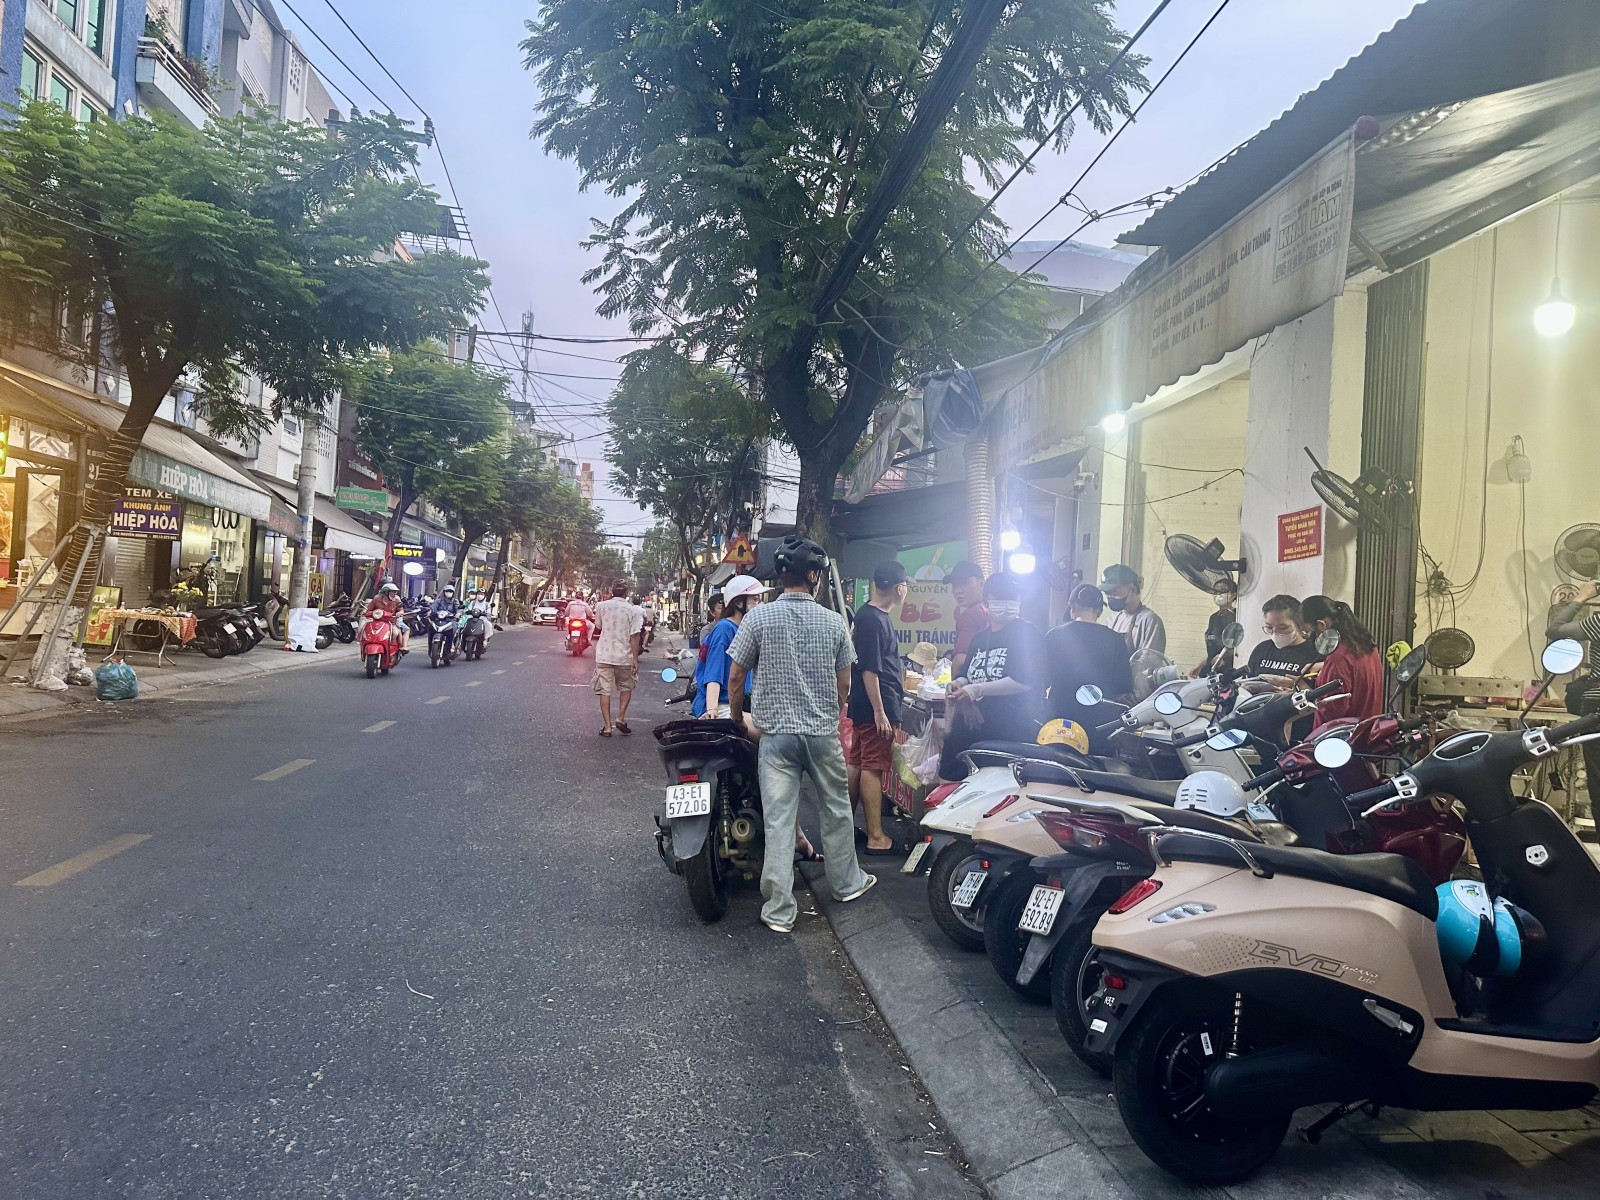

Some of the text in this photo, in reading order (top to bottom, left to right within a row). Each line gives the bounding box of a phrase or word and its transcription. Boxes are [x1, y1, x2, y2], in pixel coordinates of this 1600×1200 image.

[160, 464, 188, 495] HIỆP
[189, 473, 208, 499] HÒA
[125, 486, 173, 499] TEM XE
[123, 501, 172, 512] KHUNG ẢNH
[113, 510, 147, 530] HIỆP
[149, 512, 178, 531] HÒA
[900, 597, 942, 623] BÉ
[916, 628, 957, 645] TRÁNG
[1259, 659, 1300, 673] SUMMER
[673, 786, 702, 800] 43-E1
[669, 799, 707, 815] 572.06
[1032, 888, 1058, 911] 92-E1
[1022, 907, 1053, 931] 592.89
[1248, 940, 1346, 978] EVO
